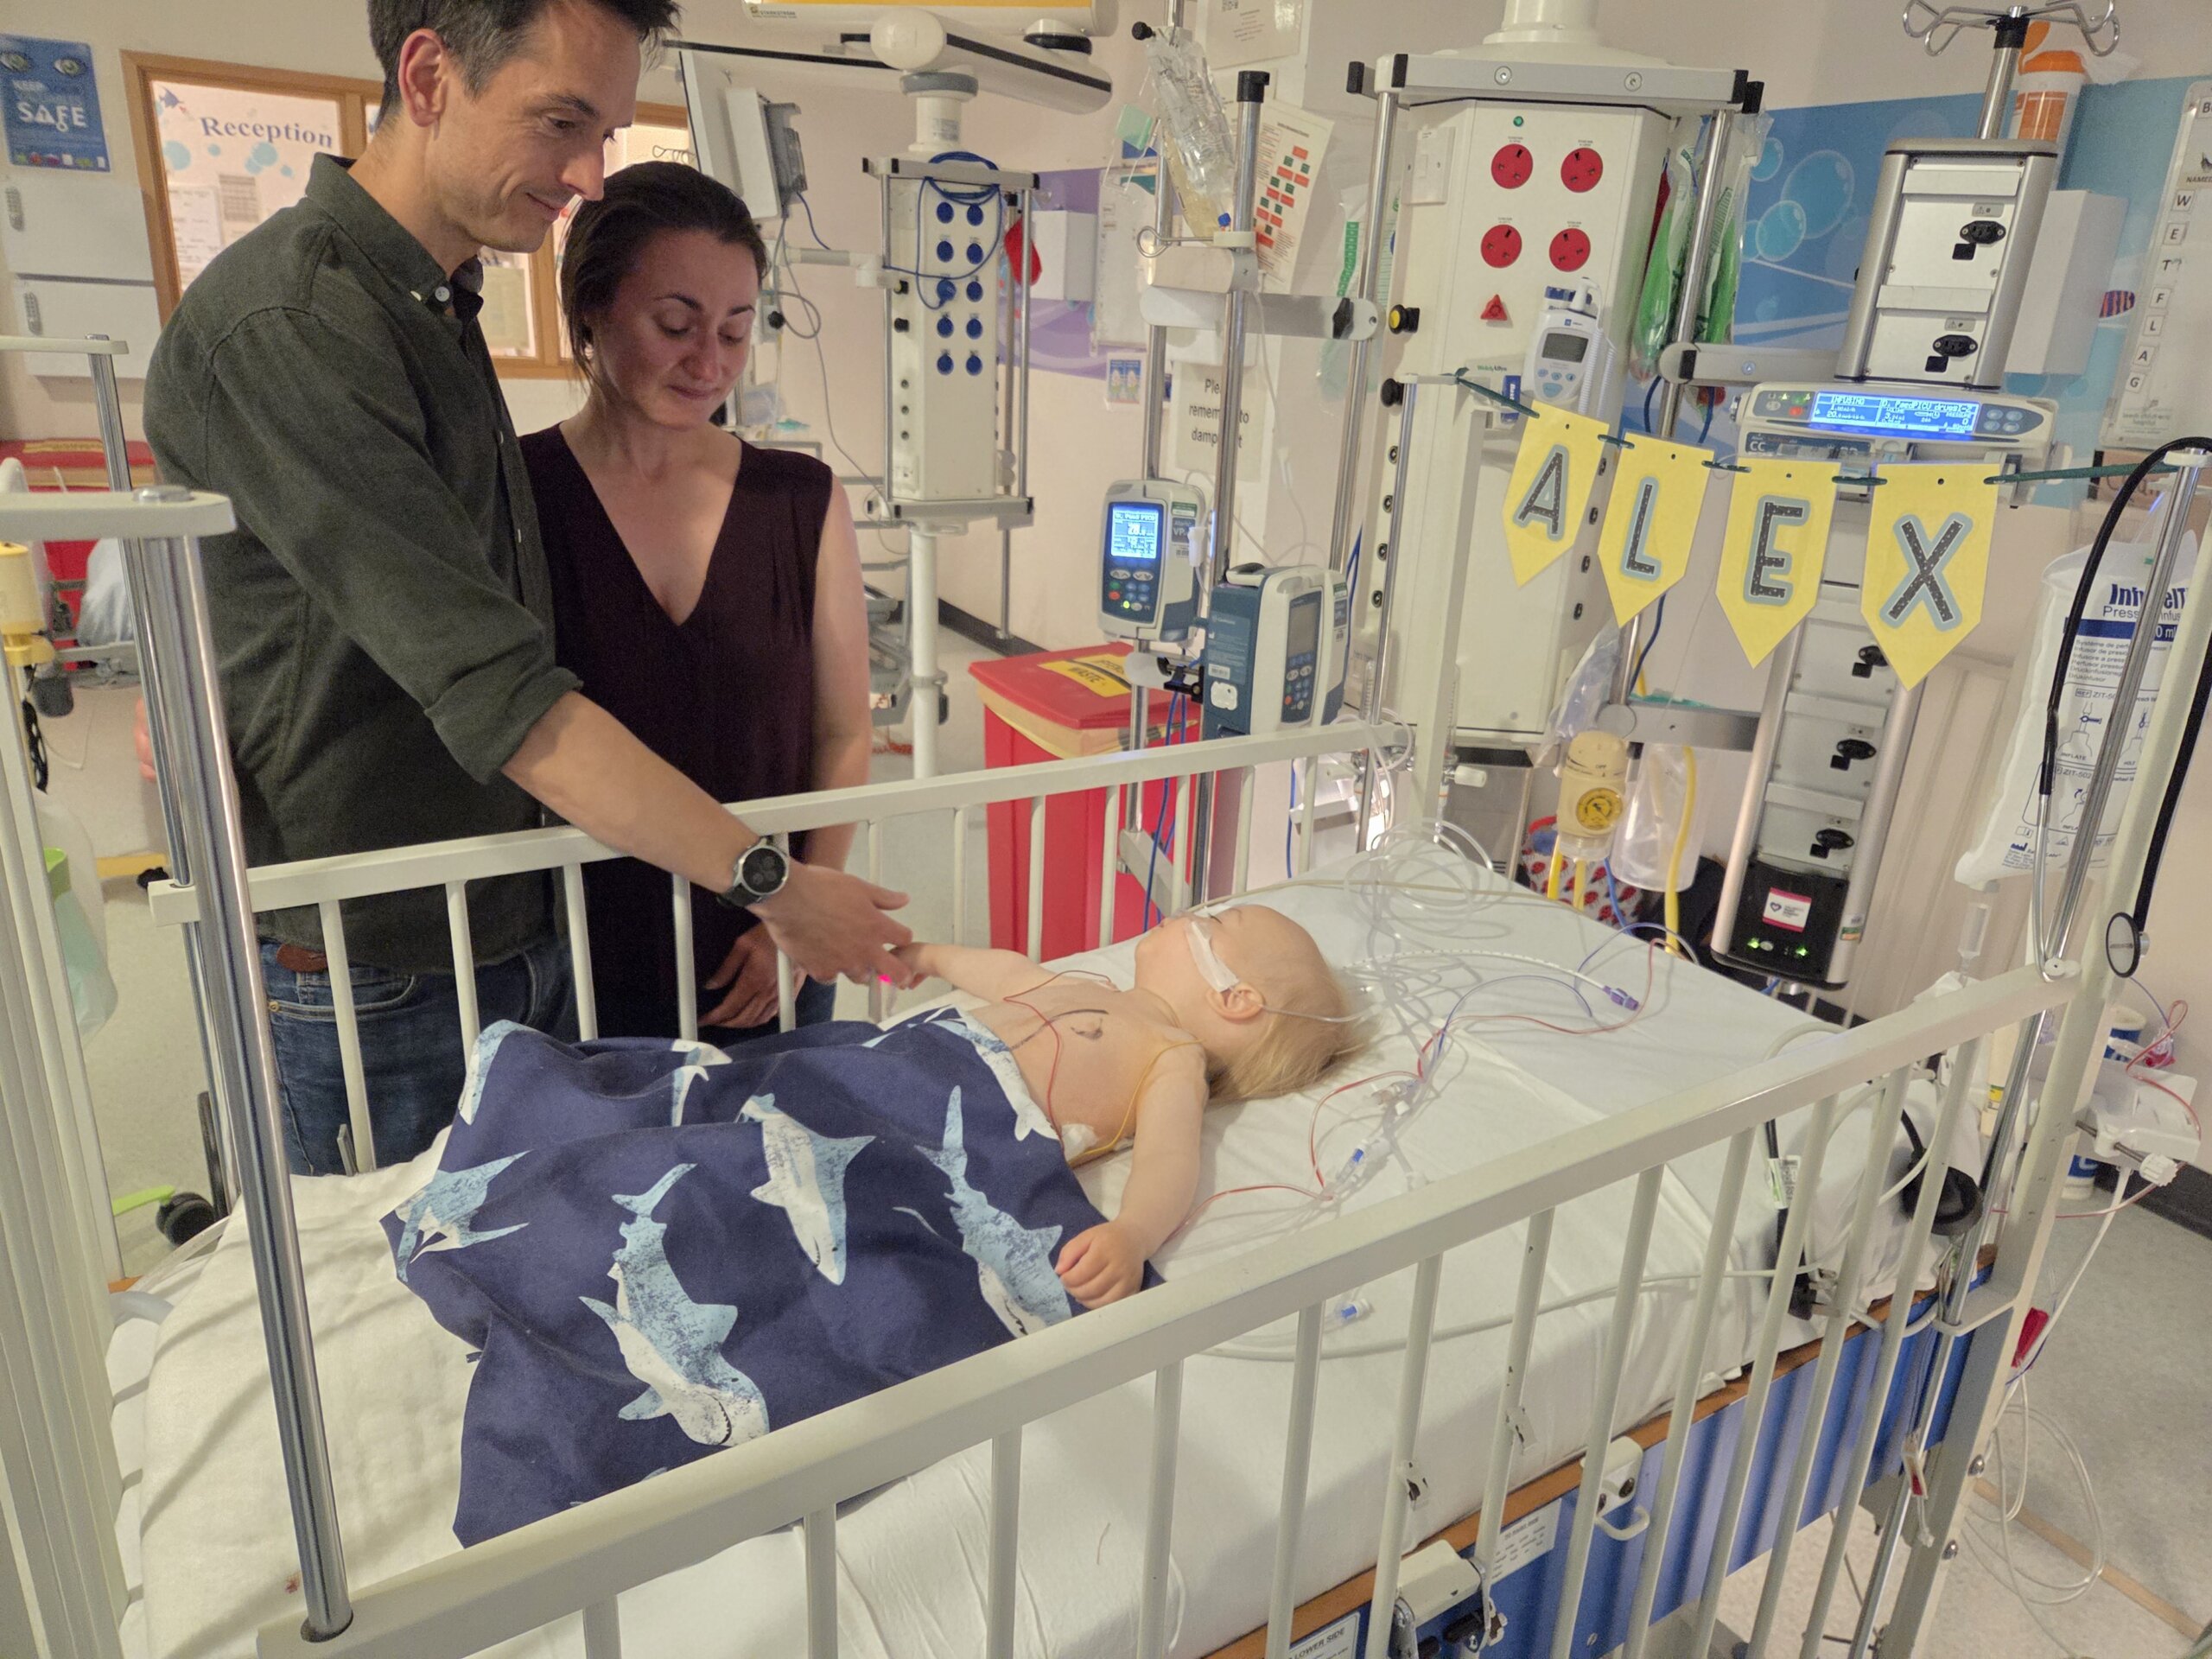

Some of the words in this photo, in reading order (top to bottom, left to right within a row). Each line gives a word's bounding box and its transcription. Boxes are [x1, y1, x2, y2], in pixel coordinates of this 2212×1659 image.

[17, 101, 88, 132] SAFE
[200, 117, 333, 148] Reception
[2177, 195, 2191, 207] W
[2170, 228, 2179, 240] E
[2156, 293, 2165, 303] F
[2150, 321, 2157, 332] L
[2138, 351, 2148, 361] A
[1205, 378, 1220, 394] Ple
[2130, 377, 2140, 387] G
[1750, 441, 1766, 452] CC
[1294, 1638, 1325, 1659] LOWER
[1327, 1627, 1345, 1643] SIDE
